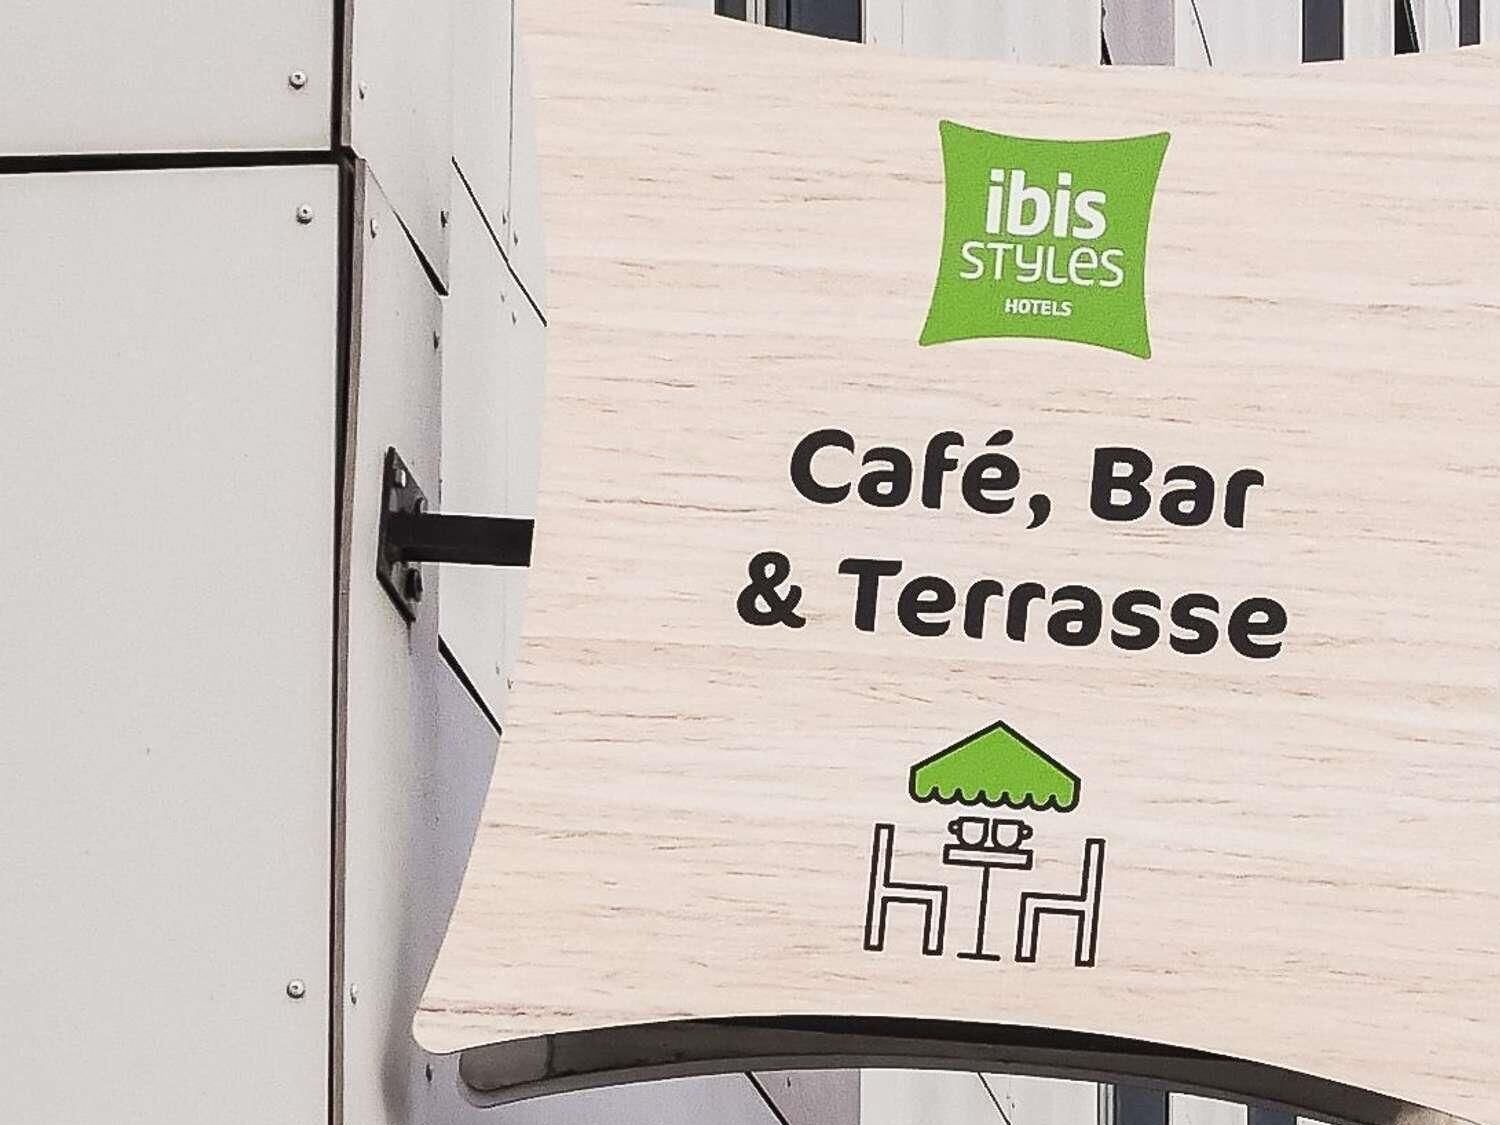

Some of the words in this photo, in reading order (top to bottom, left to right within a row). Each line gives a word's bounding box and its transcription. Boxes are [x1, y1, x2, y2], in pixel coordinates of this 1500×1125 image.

[986, 168, 1107, 239] ibis
[1004, 299, 1072, 316] HOTELS
[790, 428, 1051, 529] Café,
[1090, 447, 1265, 528] Bar
[736, 550, 806, 629] &
[837, 557, 1288, 659] Terrasse
